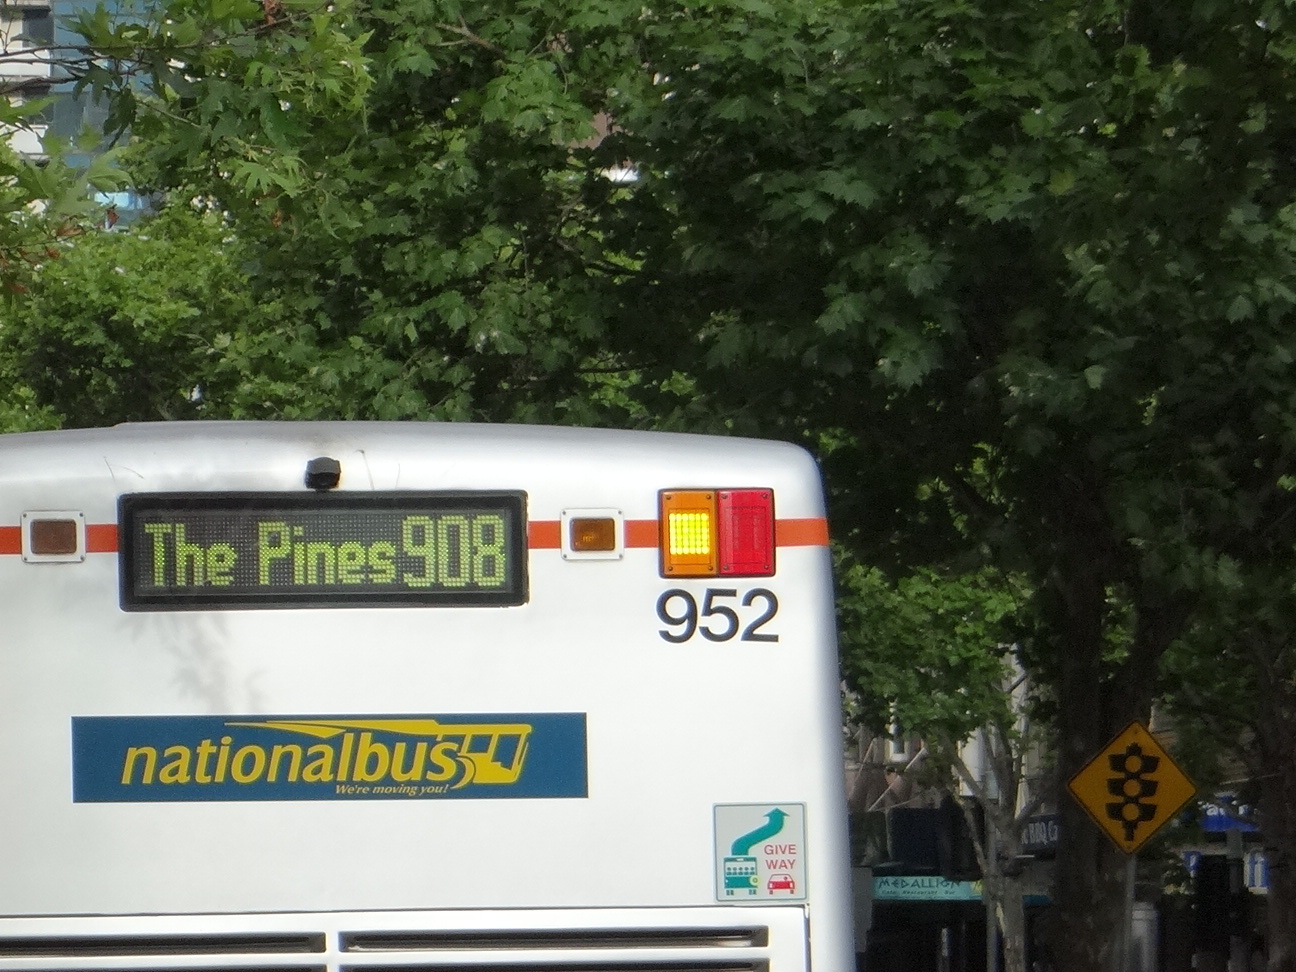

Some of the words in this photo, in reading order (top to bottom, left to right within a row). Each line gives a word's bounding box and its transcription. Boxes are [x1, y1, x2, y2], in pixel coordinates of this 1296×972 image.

[144, 522, 238, 587] The
[257, 520, 397, 586] Pines
[402, 515, 506, 588] 908
[655, 587, 780, 644] 952
[120, 730, 461, 785] nationalbus
[335, 784, 370, 794] We're
[372, 784, 418, 796] moving
[419, 784, 449, 796] you!
[763, 844, 797, 855] GIVE
[765, 859, 796, 870] WAY
